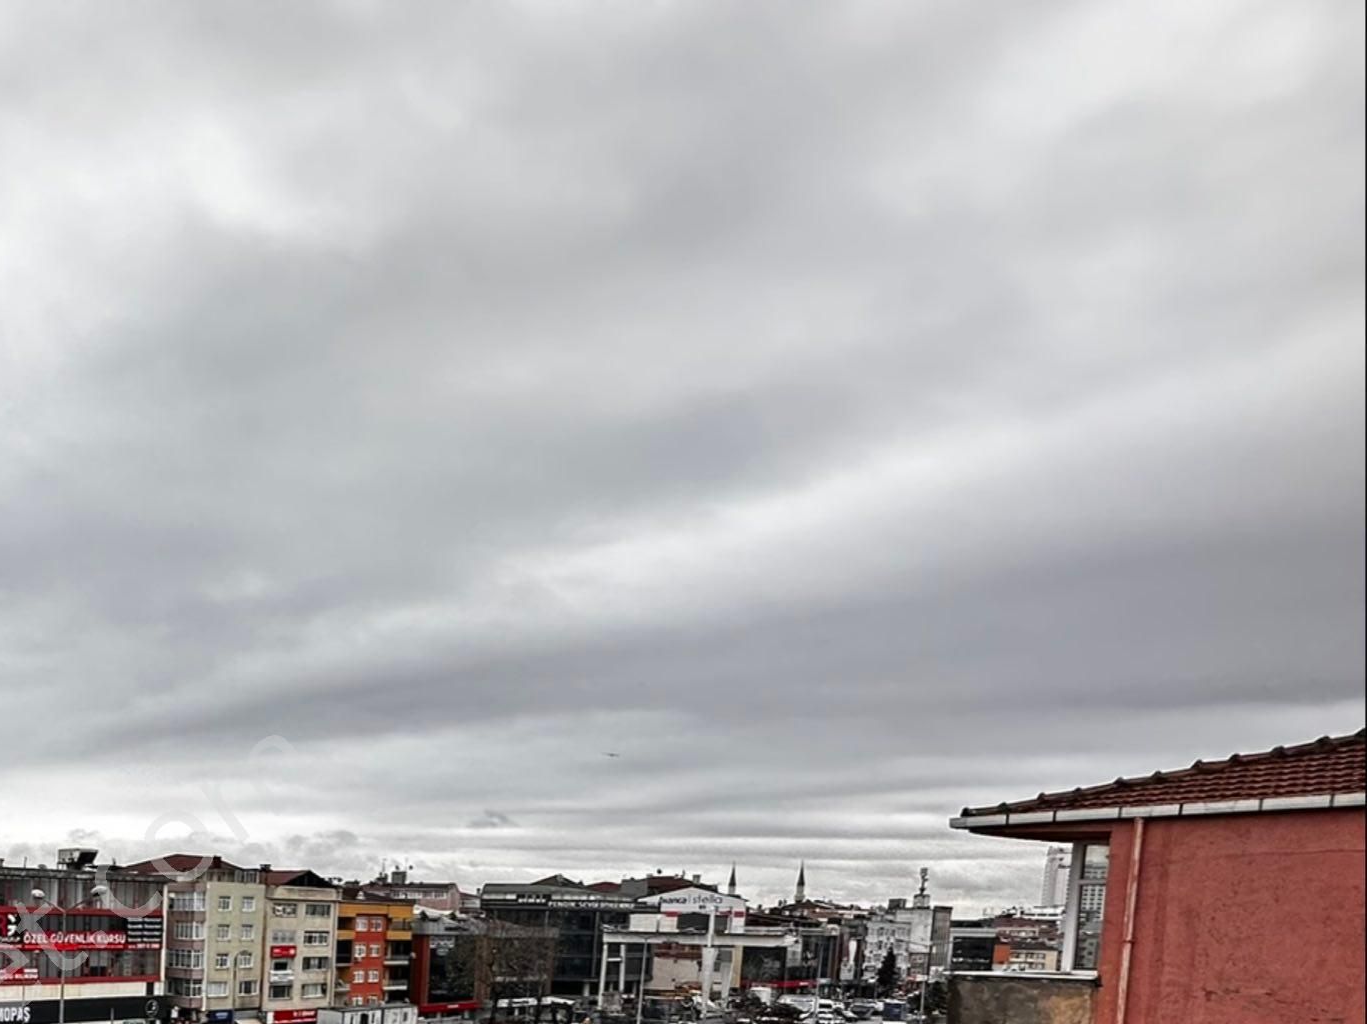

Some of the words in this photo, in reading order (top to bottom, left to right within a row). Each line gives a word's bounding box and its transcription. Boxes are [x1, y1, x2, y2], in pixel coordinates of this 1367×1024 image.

[23, 930, 49, 944] ÖZEL
[50, 931, 94, 945] GÜVENLİK
[95, 933, 126, 944] KURSU
